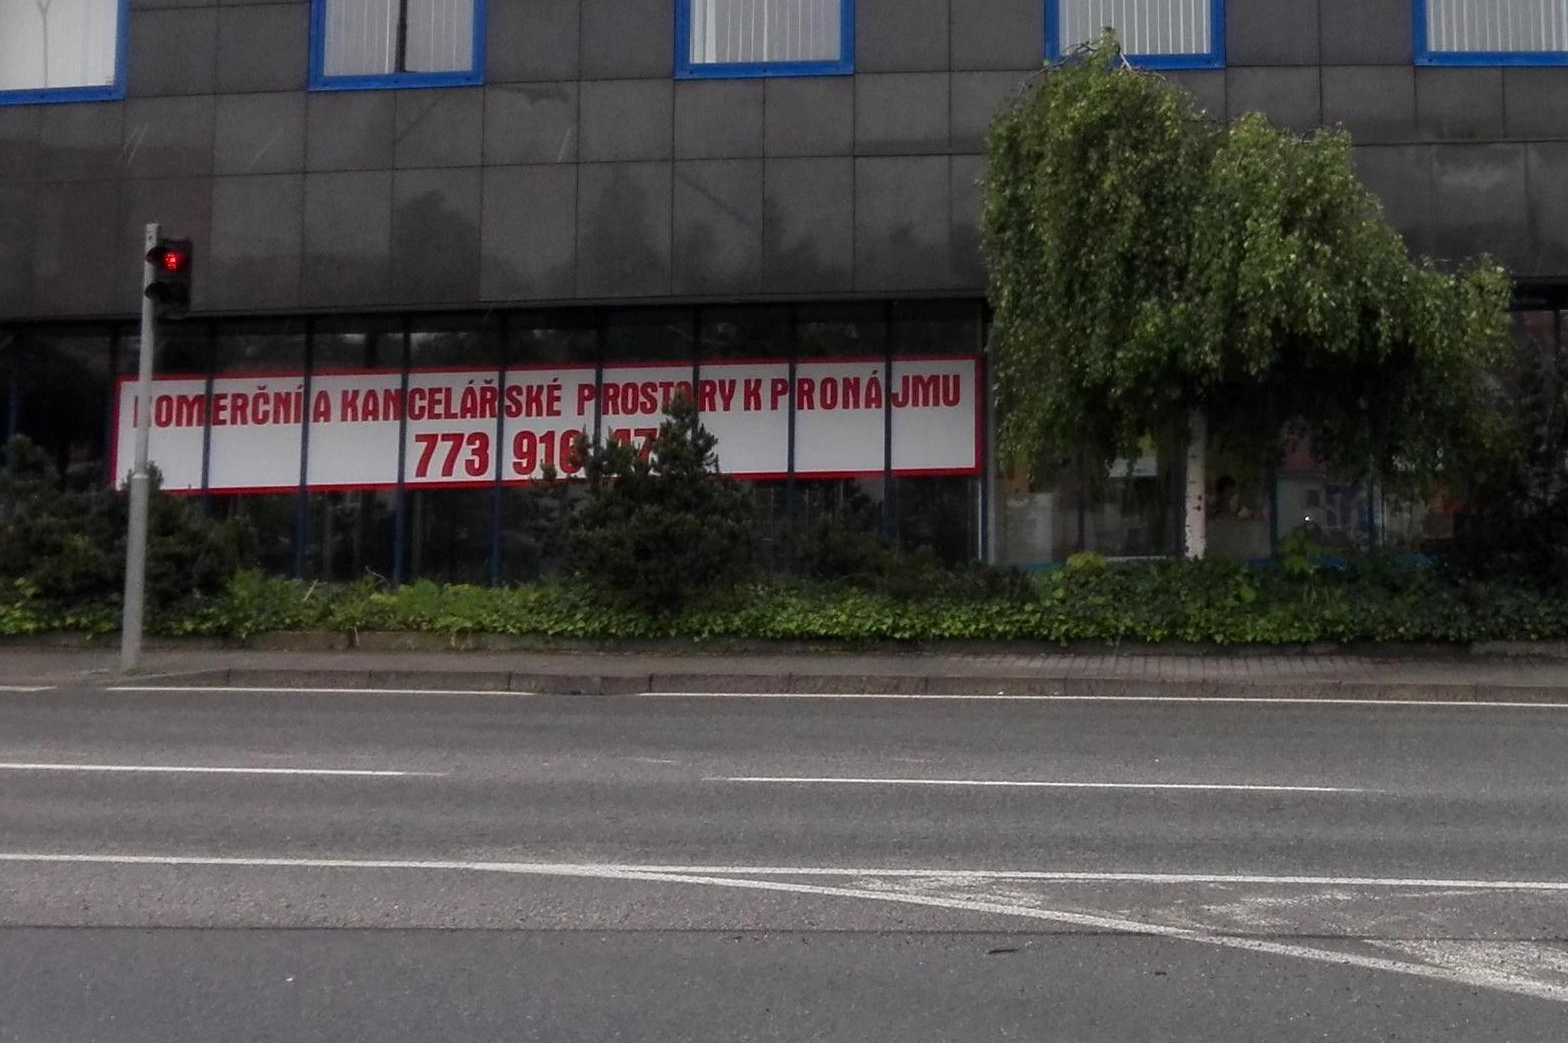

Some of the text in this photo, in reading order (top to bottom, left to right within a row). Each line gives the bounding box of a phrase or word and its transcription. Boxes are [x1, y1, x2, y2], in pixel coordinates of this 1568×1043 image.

[313, 393, 331, 424] A
[340, 377, 561, 423] KANCELÁŘSKÉ
[743, 378, 763, 412] K
[770, 369, 961, 412] PRONÁJMU
[415, 431, 490, 478] 773
